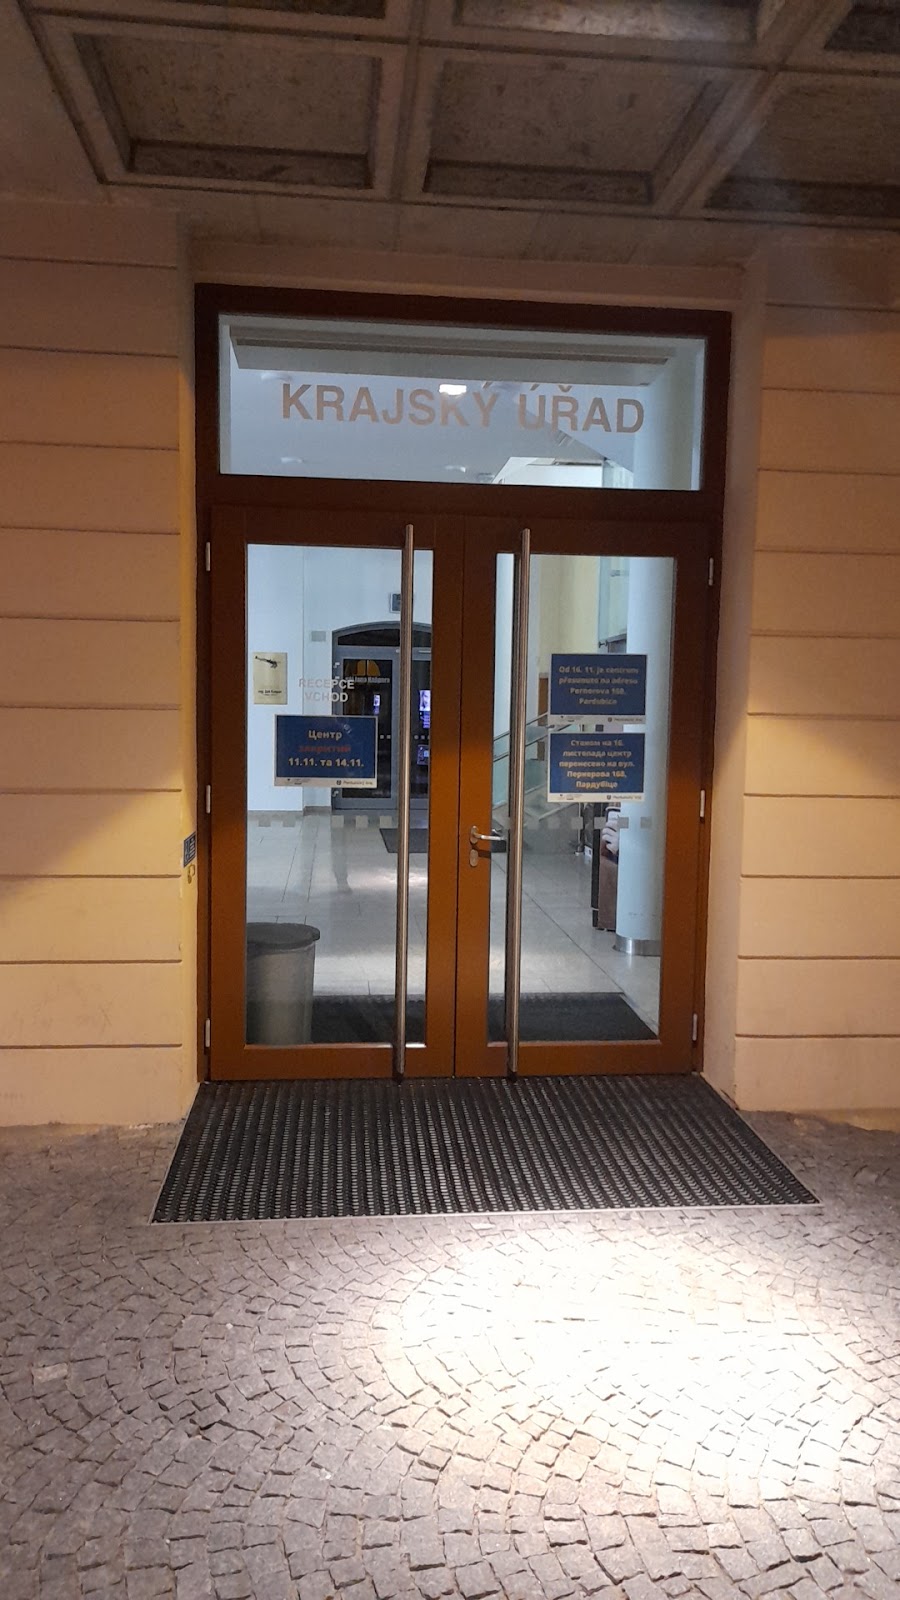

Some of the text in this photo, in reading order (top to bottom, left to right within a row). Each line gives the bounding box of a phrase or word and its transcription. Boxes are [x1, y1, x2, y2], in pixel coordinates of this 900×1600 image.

[281, 381, 645, 433] KRAJSKÝ ÚŘAD
[596, 667, 604, 675] je
[299, 678, 355, 689] RECEPCE
[305, 691, 349, 702] VCHOD
[308, 730, 342, 741] Центр
[288, 757, 364, 767] 11.11. та 14.11.
